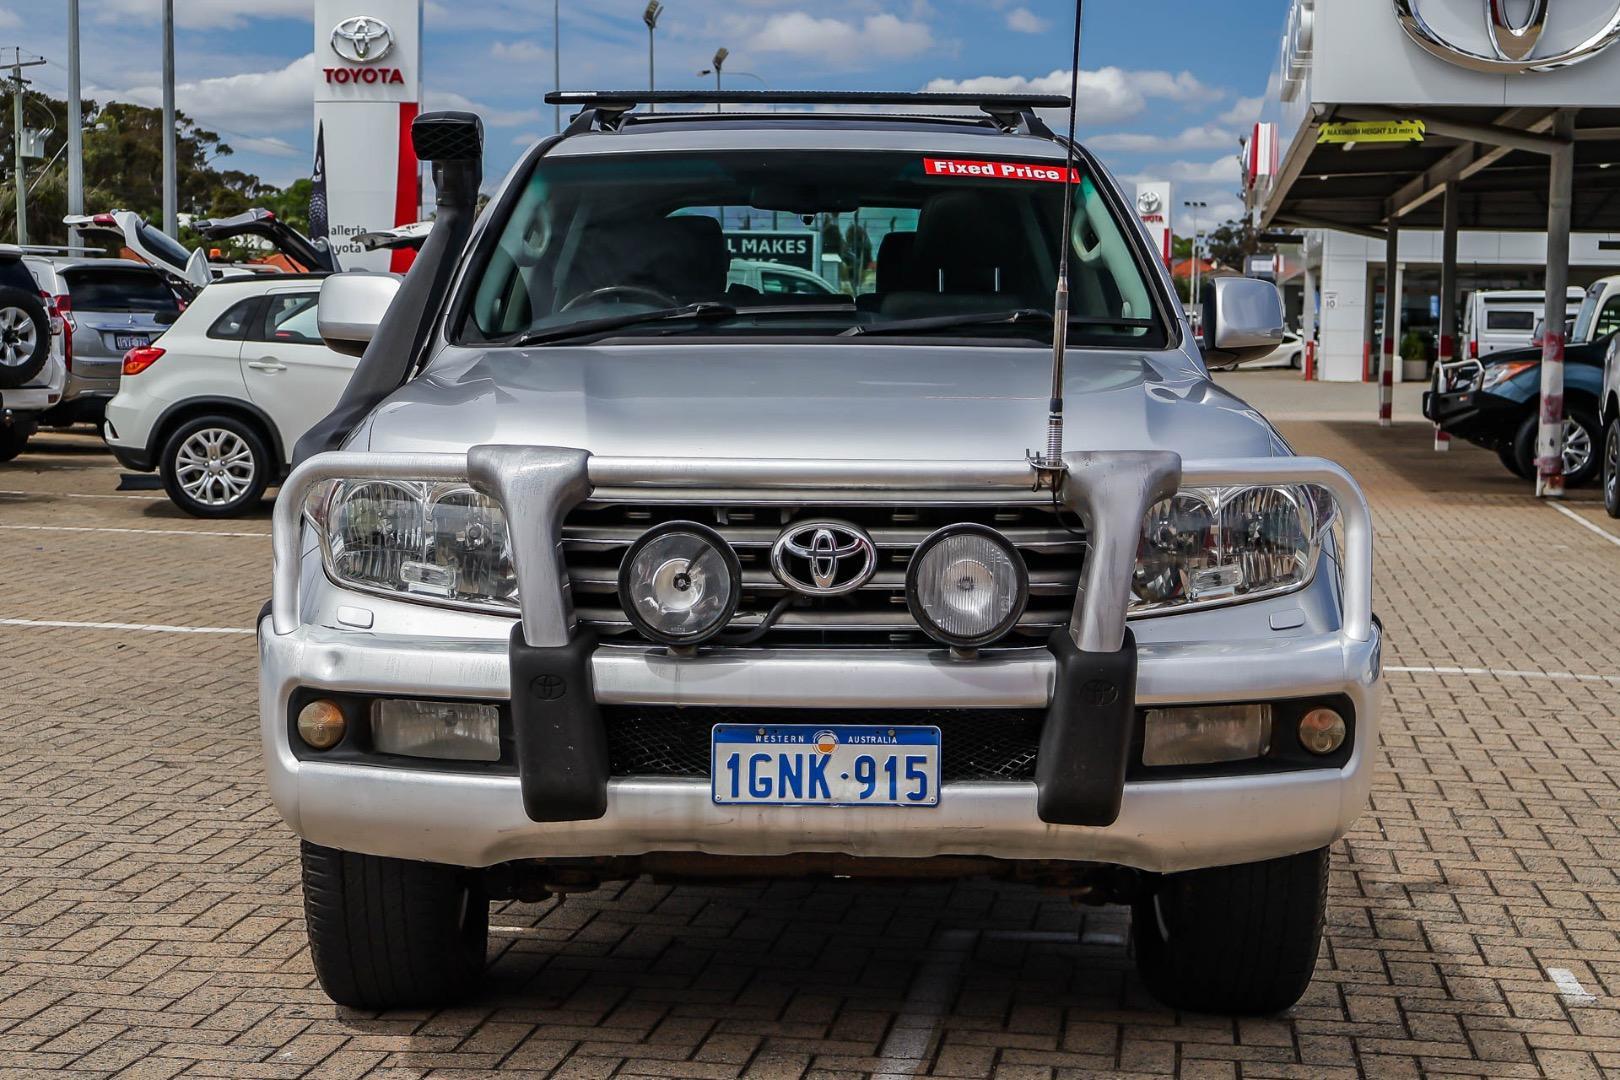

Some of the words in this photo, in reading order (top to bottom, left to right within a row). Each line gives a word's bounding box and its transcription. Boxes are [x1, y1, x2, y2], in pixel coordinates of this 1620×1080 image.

[323, 68, 404, 84] TOYOTA
[1327, 128, 1360, 136] MAXIMUM
[1361, 127, 1386, 135] HEIGHT
[934, 161, 995, 176] Fixed
[1001, 164, 1060, 180] Price
[330, 225, 367, 236] alleria
[742, 239, 807, 253] MAKES
[755, 735, 805, 743] WESTERN
[847, 736, 898, 744] AUSTRALIA
